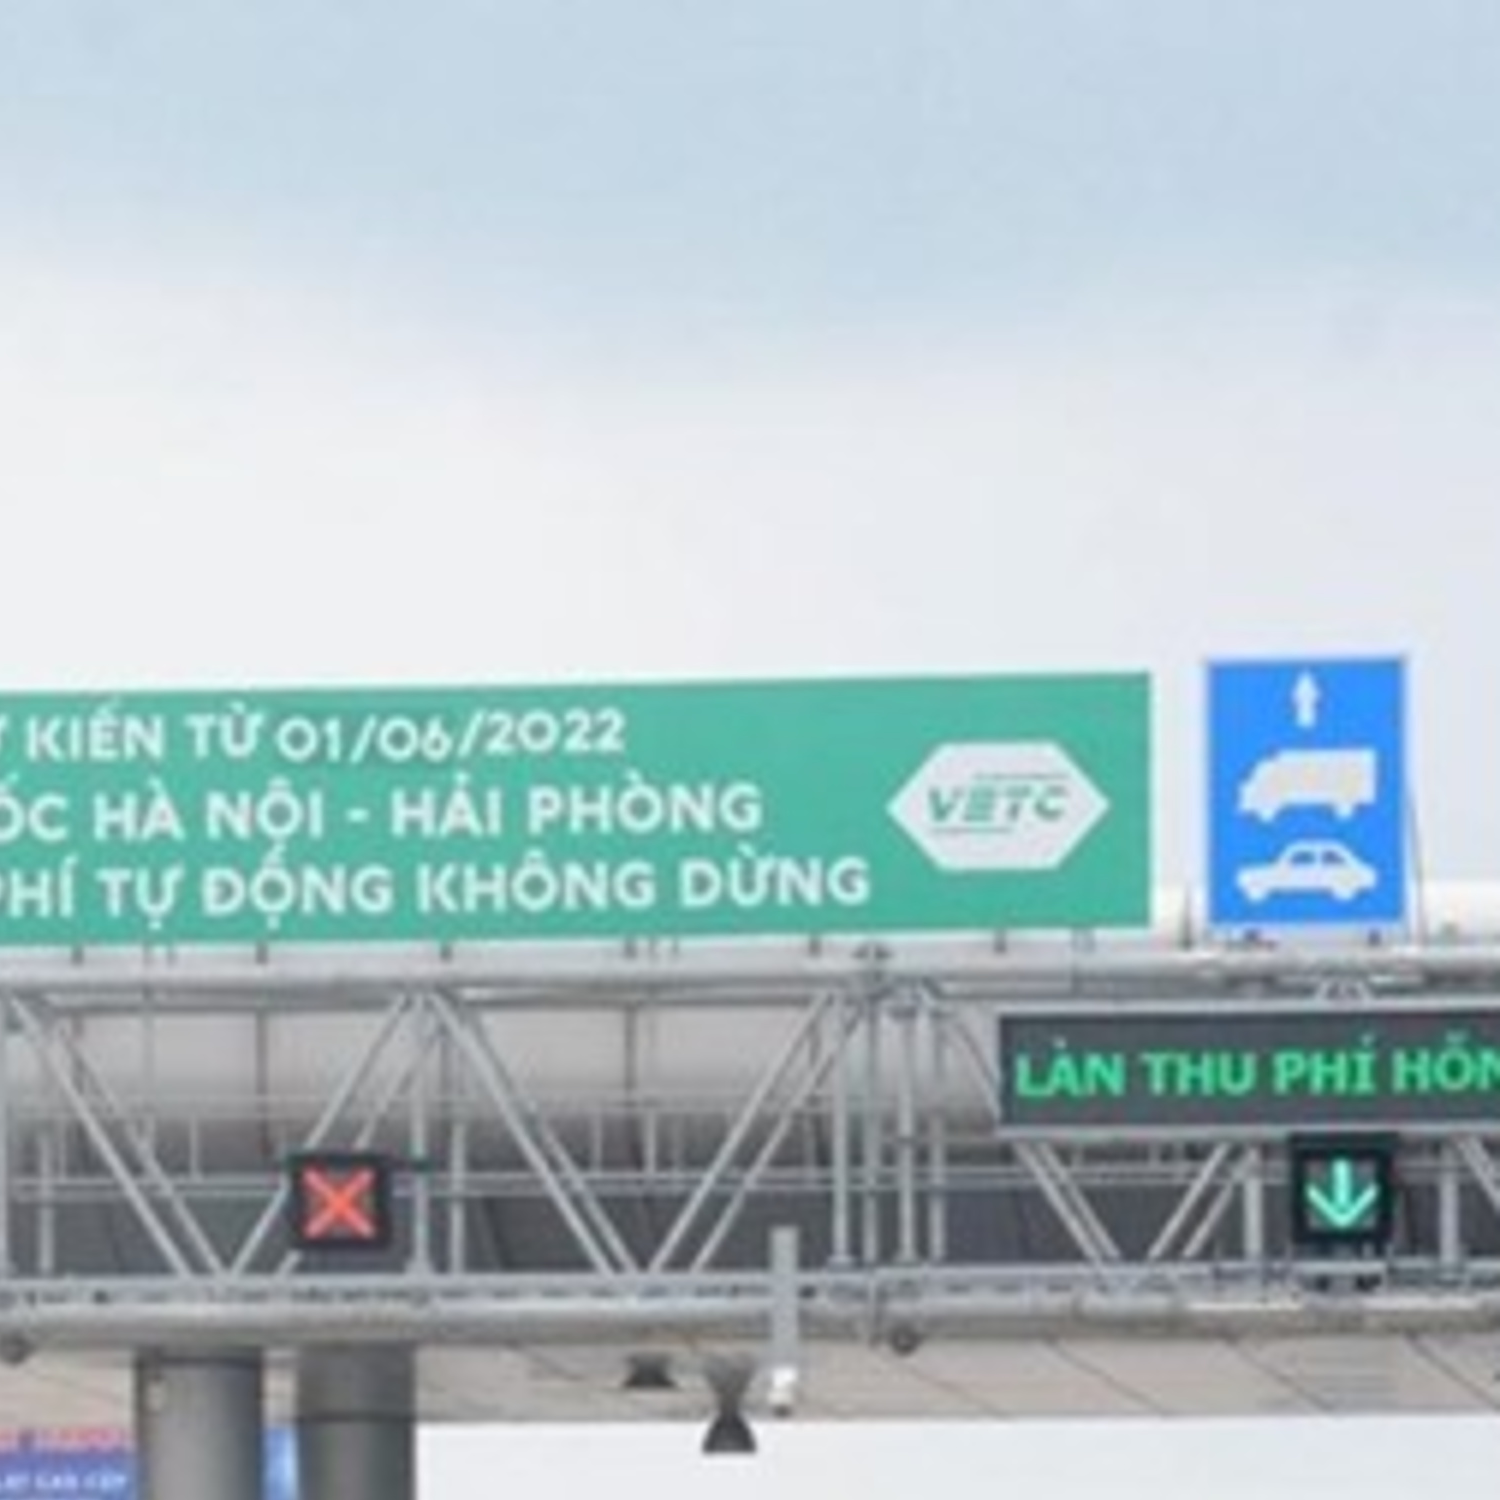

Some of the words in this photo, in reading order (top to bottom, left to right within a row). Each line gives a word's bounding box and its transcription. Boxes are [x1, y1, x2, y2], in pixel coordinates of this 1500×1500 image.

[26, 698, 166, 762] KIẾN
[185, 700, 266, 760] TỪ
[274, 706, 628, 763] 01/06/2022
[92, 776, 184, 841] HÀ
[205, 775, 326, 845] NỘI
[390, 773, 504, 837] HẢI
[526, 770, 764, 836] PHÒNG
[925, 784, 1072, 824] VETC
[95, 866, 187, 930] TỰ
[200, 848, 396, 930] ĐỘNG
[416, 848, 658, 915] KHÔNG
[678, 842, 873, 909] DỪNG
[1015, 1037, 1127, 1097] LÀN
[1140, 1051, 1258, 1096] THU
[1272, 1032, 1378, 1095] PHÍ
